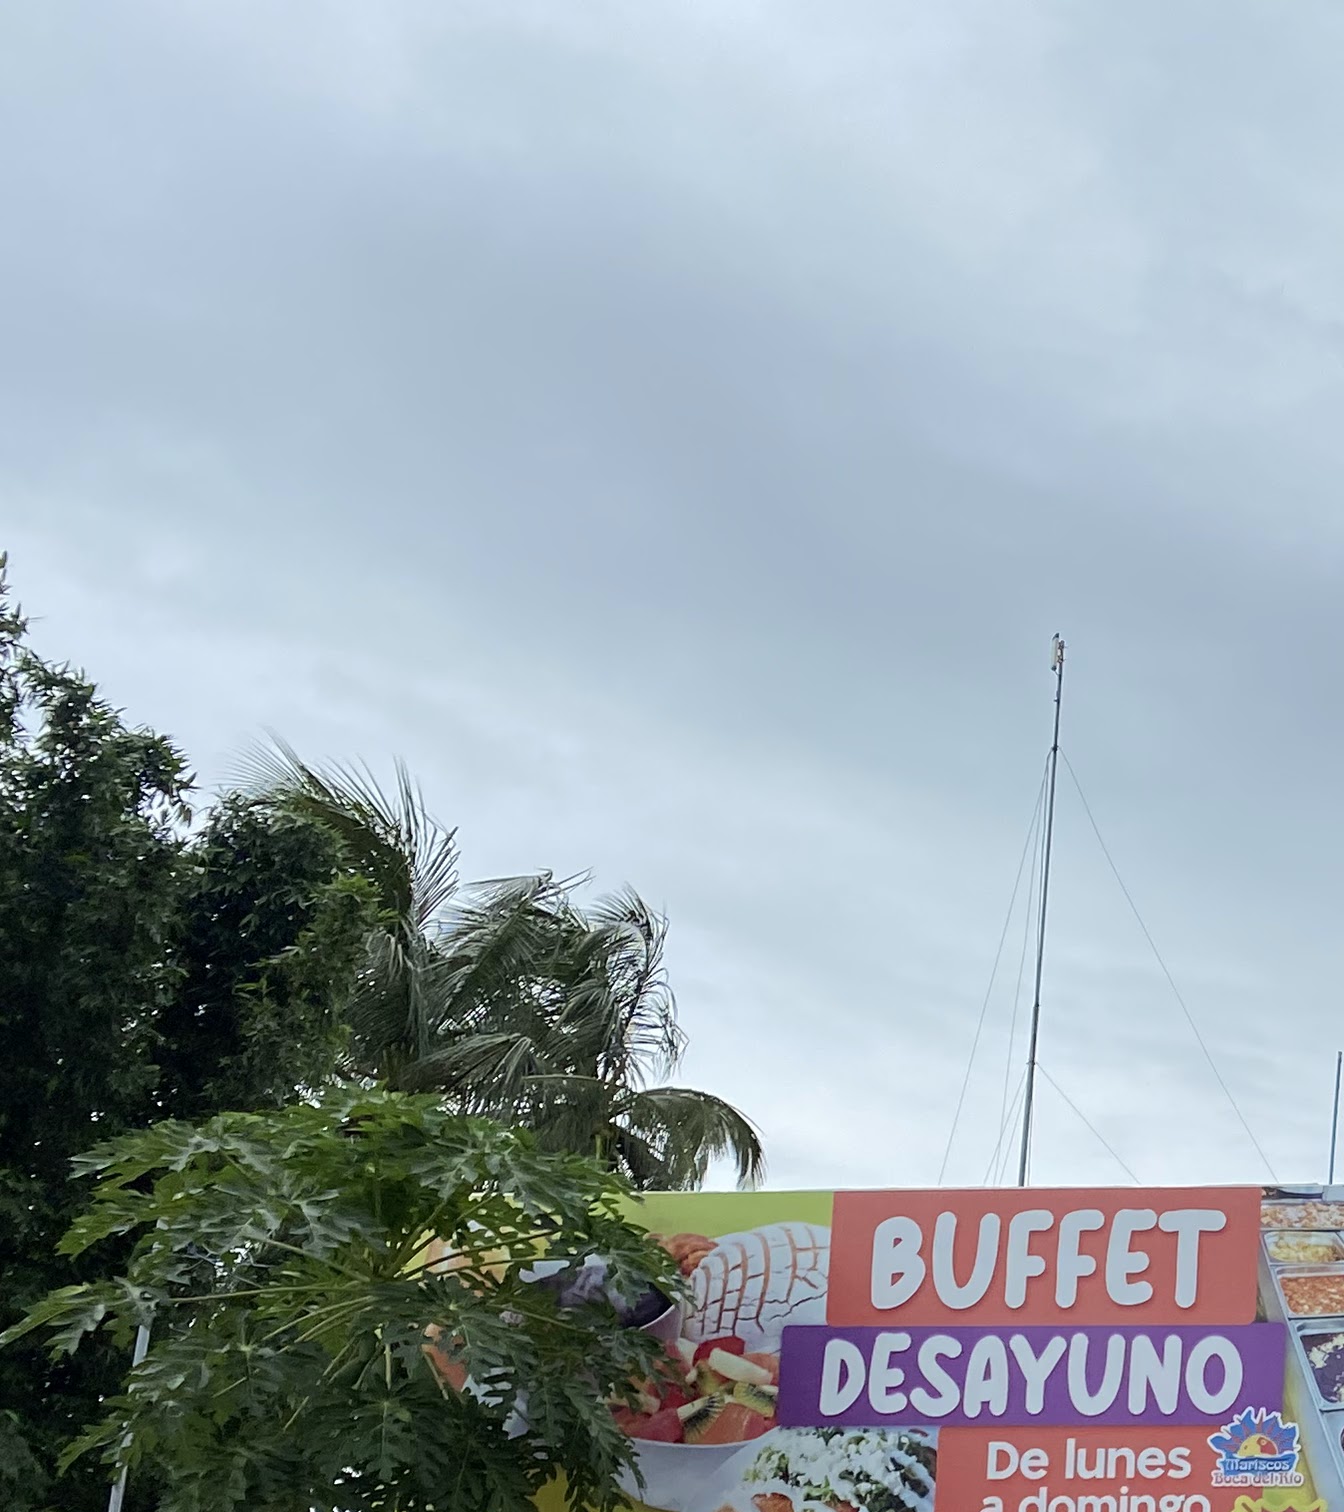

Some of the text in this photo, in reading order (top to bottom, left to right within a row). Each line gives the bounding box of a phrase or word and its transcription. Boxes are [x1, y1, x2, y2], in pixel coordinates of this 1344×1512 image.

[870, 1208, 1227, 1311] BUFFET
[819, 1332, 1243, 1420] DESAYUNO
[986, 1438, 1192, 1481] De lunes
[1214, 1472, 1249, 1485] Boca
[1252, 1472, 1275, 1485] del
[1225, 1458, 1290, 1471] Mariscos
